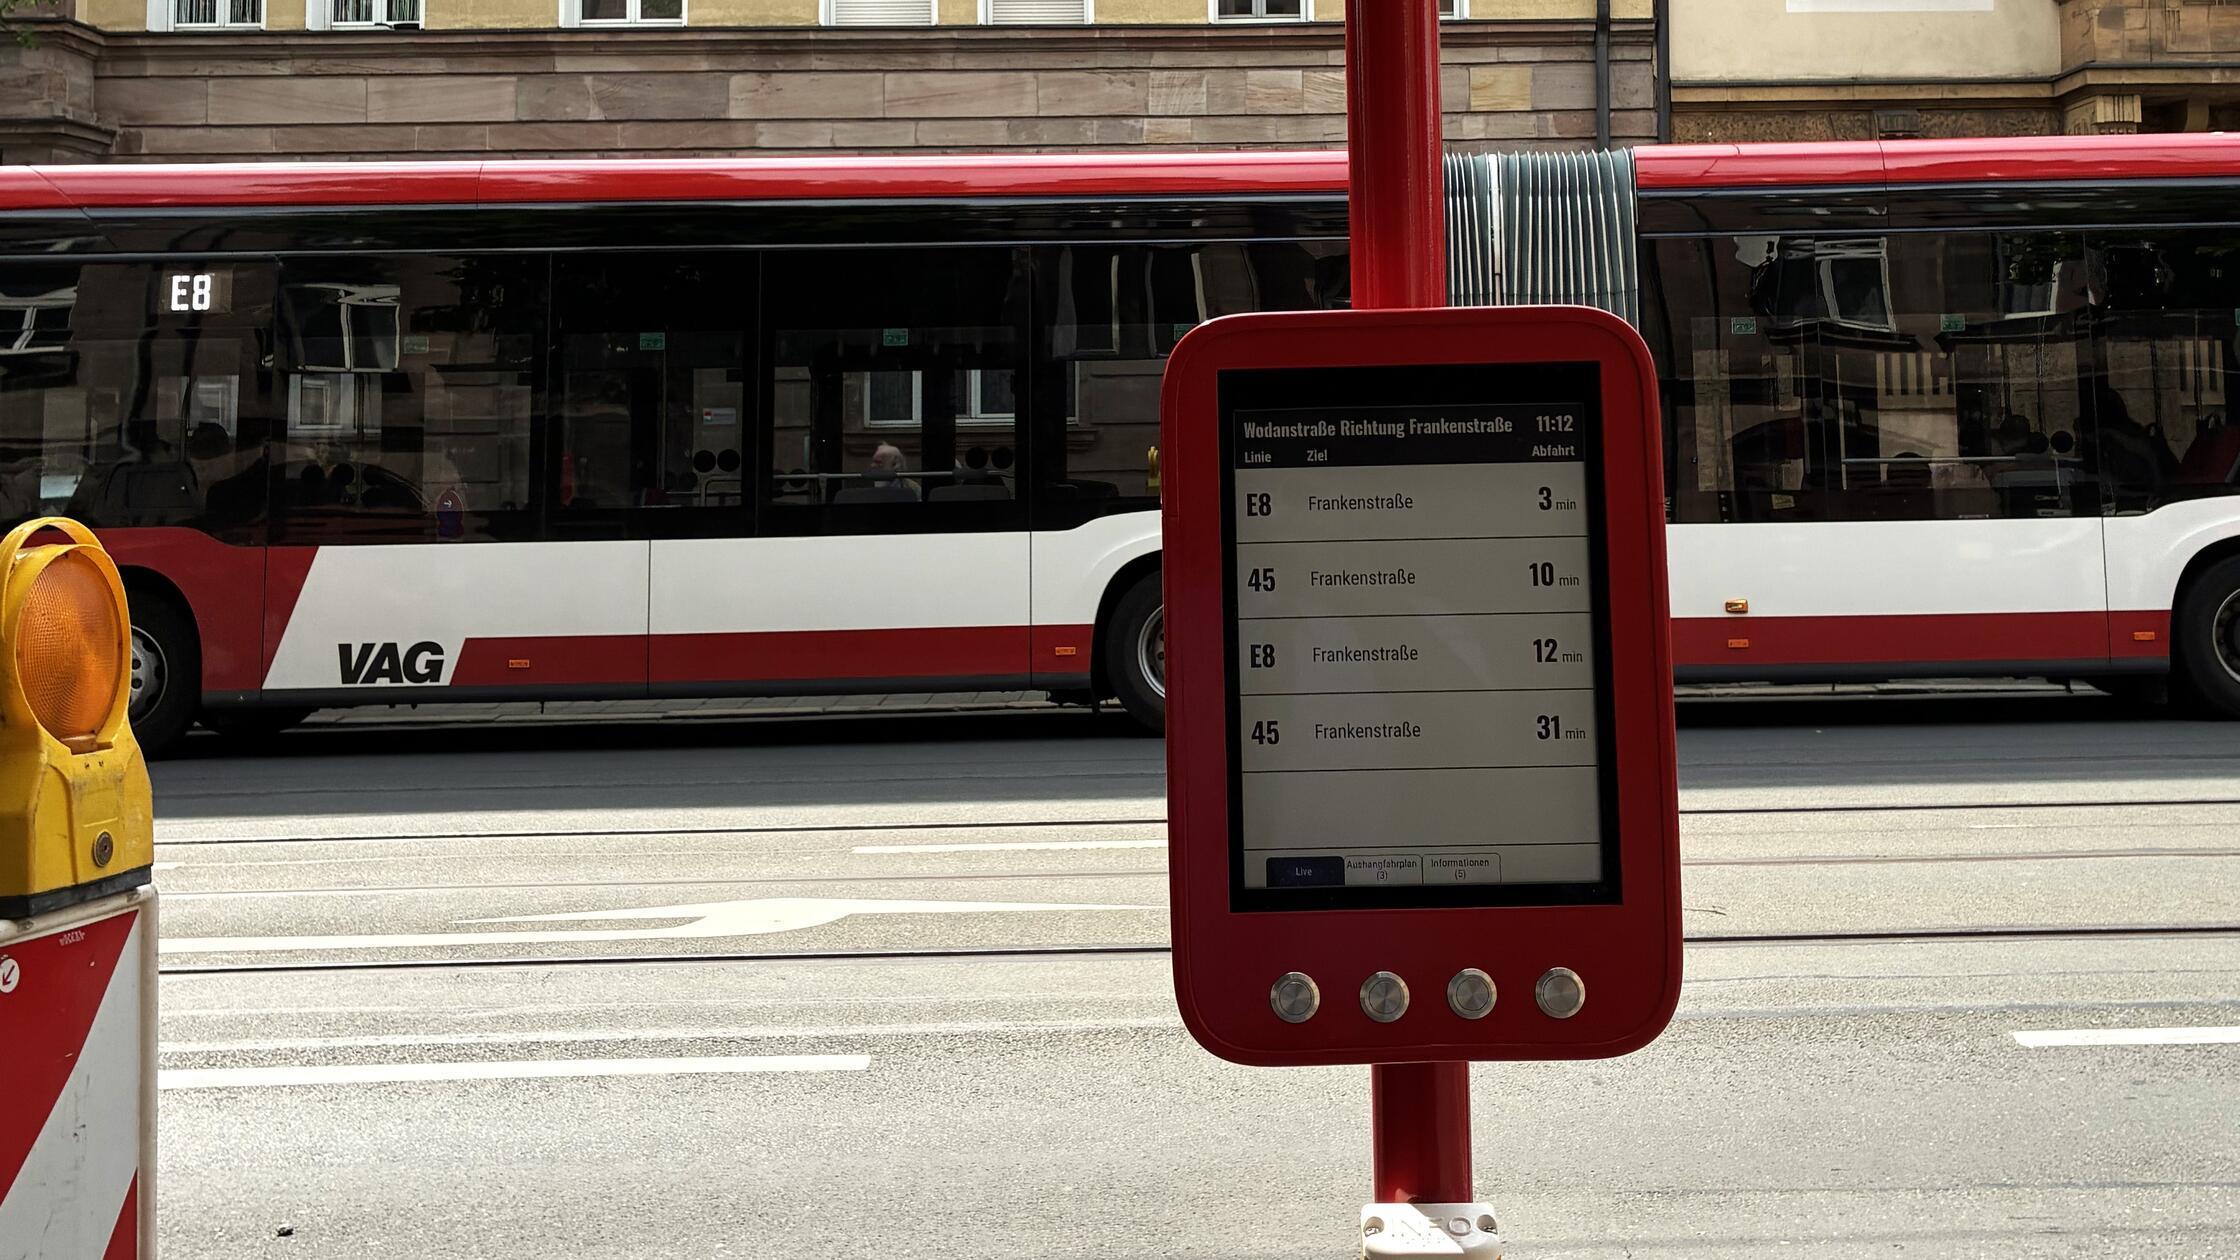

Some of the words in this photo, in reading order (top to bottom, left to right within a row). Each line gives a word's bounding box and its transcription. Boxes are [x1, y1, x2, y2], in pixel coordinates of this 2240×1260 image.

[171, 274, 211, 311] E8
[1243, 420, 1336, 439] Wodanstraße
[1340, 419, 1405, 439] Richtung
[1409, 417, 1513, 435] Frankenstraße
[1536, 415, 1574, 433] 11:12
[1244, 451, 1272, 464] Linie
[1307, 449, 1328, 462] Ziel
[1532, 444, 1576, 457] Abfahrt
[1246, 492, 1272, 517] E8
[1308, 494, 1413, 512] Frankenstraße
[1538, 486, 1552, 511] 3
[1556, 498, 1577, 511] min
[1247, 568, 1276, 592] 45
[1310, 569, 1416, 587] Frankenstraße
[1528, 562, 1554, 587] 10
[1559, 574, 1580, 587] min
[1250, 644, 1276, 668] E8
[1312, 645, 1419, 663] Frankenstraße
[1533, 638, 1558, 663] 12
[1562, 651, 1583, 663] min
[338, 641, 445, 685] VAG
[1251, 720, 1280, 745] 45
[1314, 722, 1421, 740] Frankenstraße
[1536, 715, 1561, 740] 31
[1565, 728, 1586, 740] min
[1295, 866, 1313, 877] Live
[1346, 858, 1418, 871] Aushangfahrplan
[1430, 857, 1490, 869] Informationen
[1376, 870, 1388, 881] (3)
